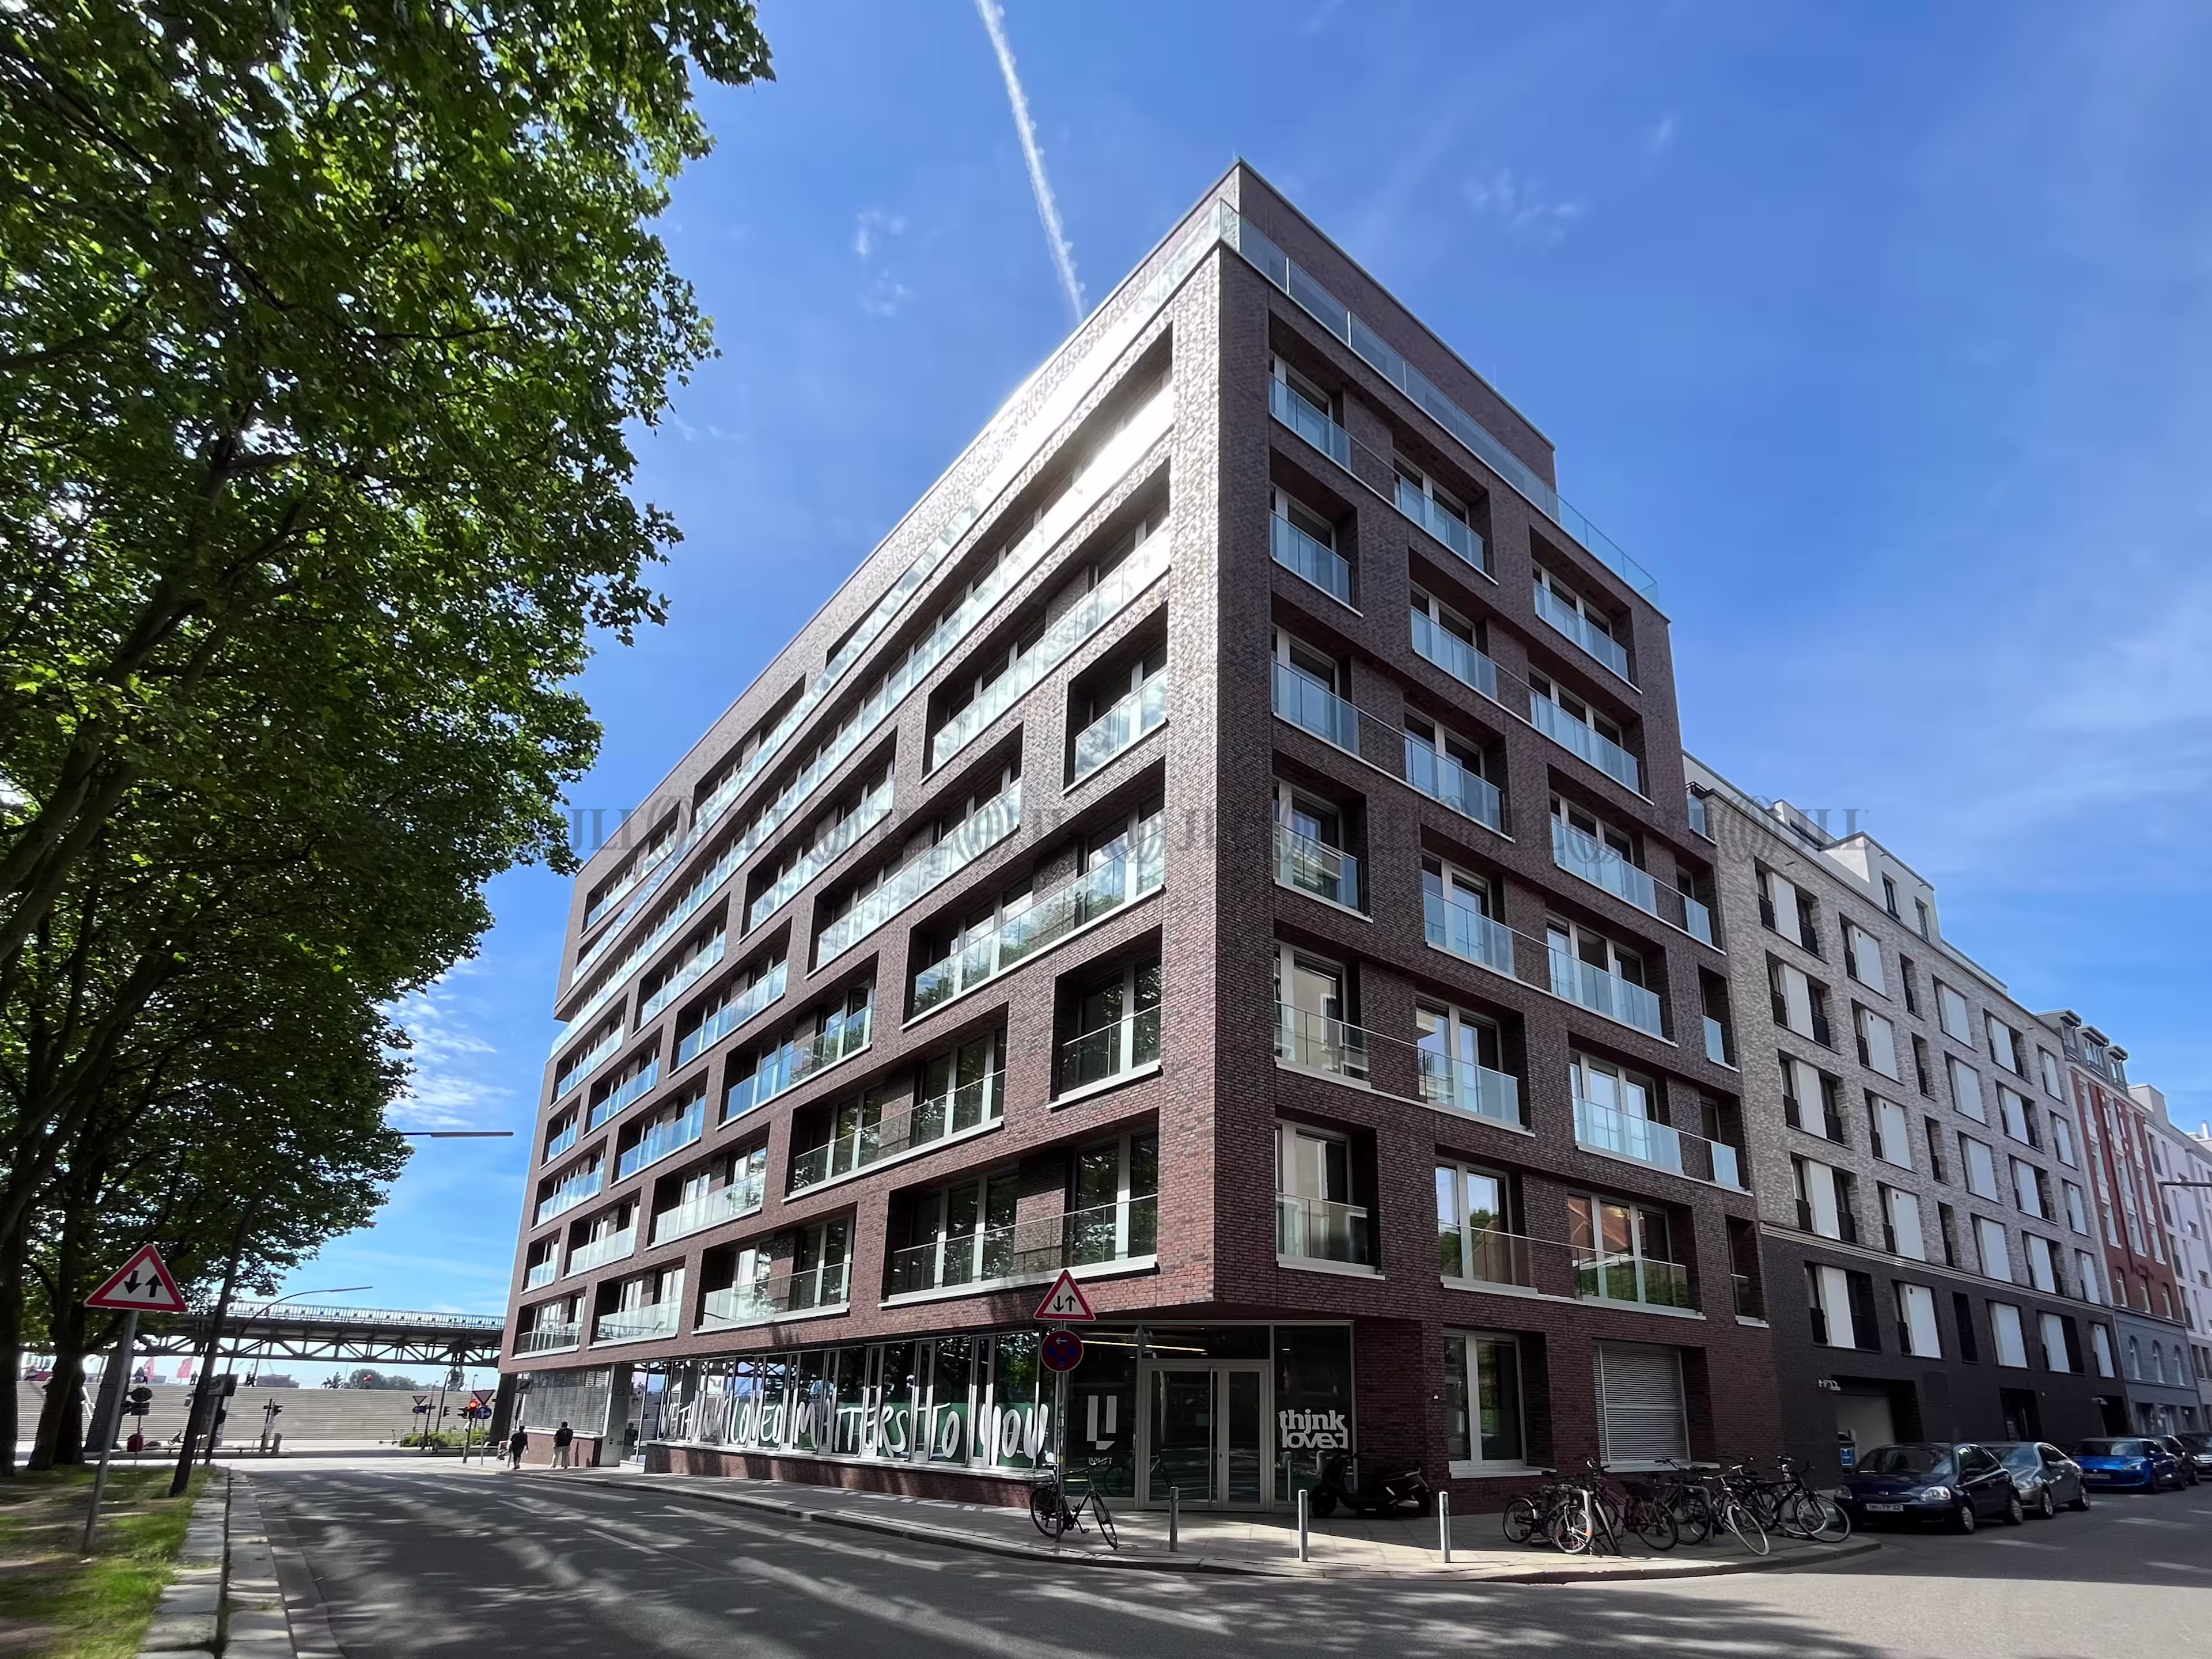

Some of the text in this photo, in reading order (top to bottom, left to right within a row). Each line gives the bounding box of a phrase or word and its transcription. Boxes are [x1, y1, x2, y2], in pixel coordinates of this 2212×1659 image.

[730, 1397, 783, 1445] LOVED
[794, 1398, 908, 1458] MATTERS
[917, 1402, 960, 1460] TO
